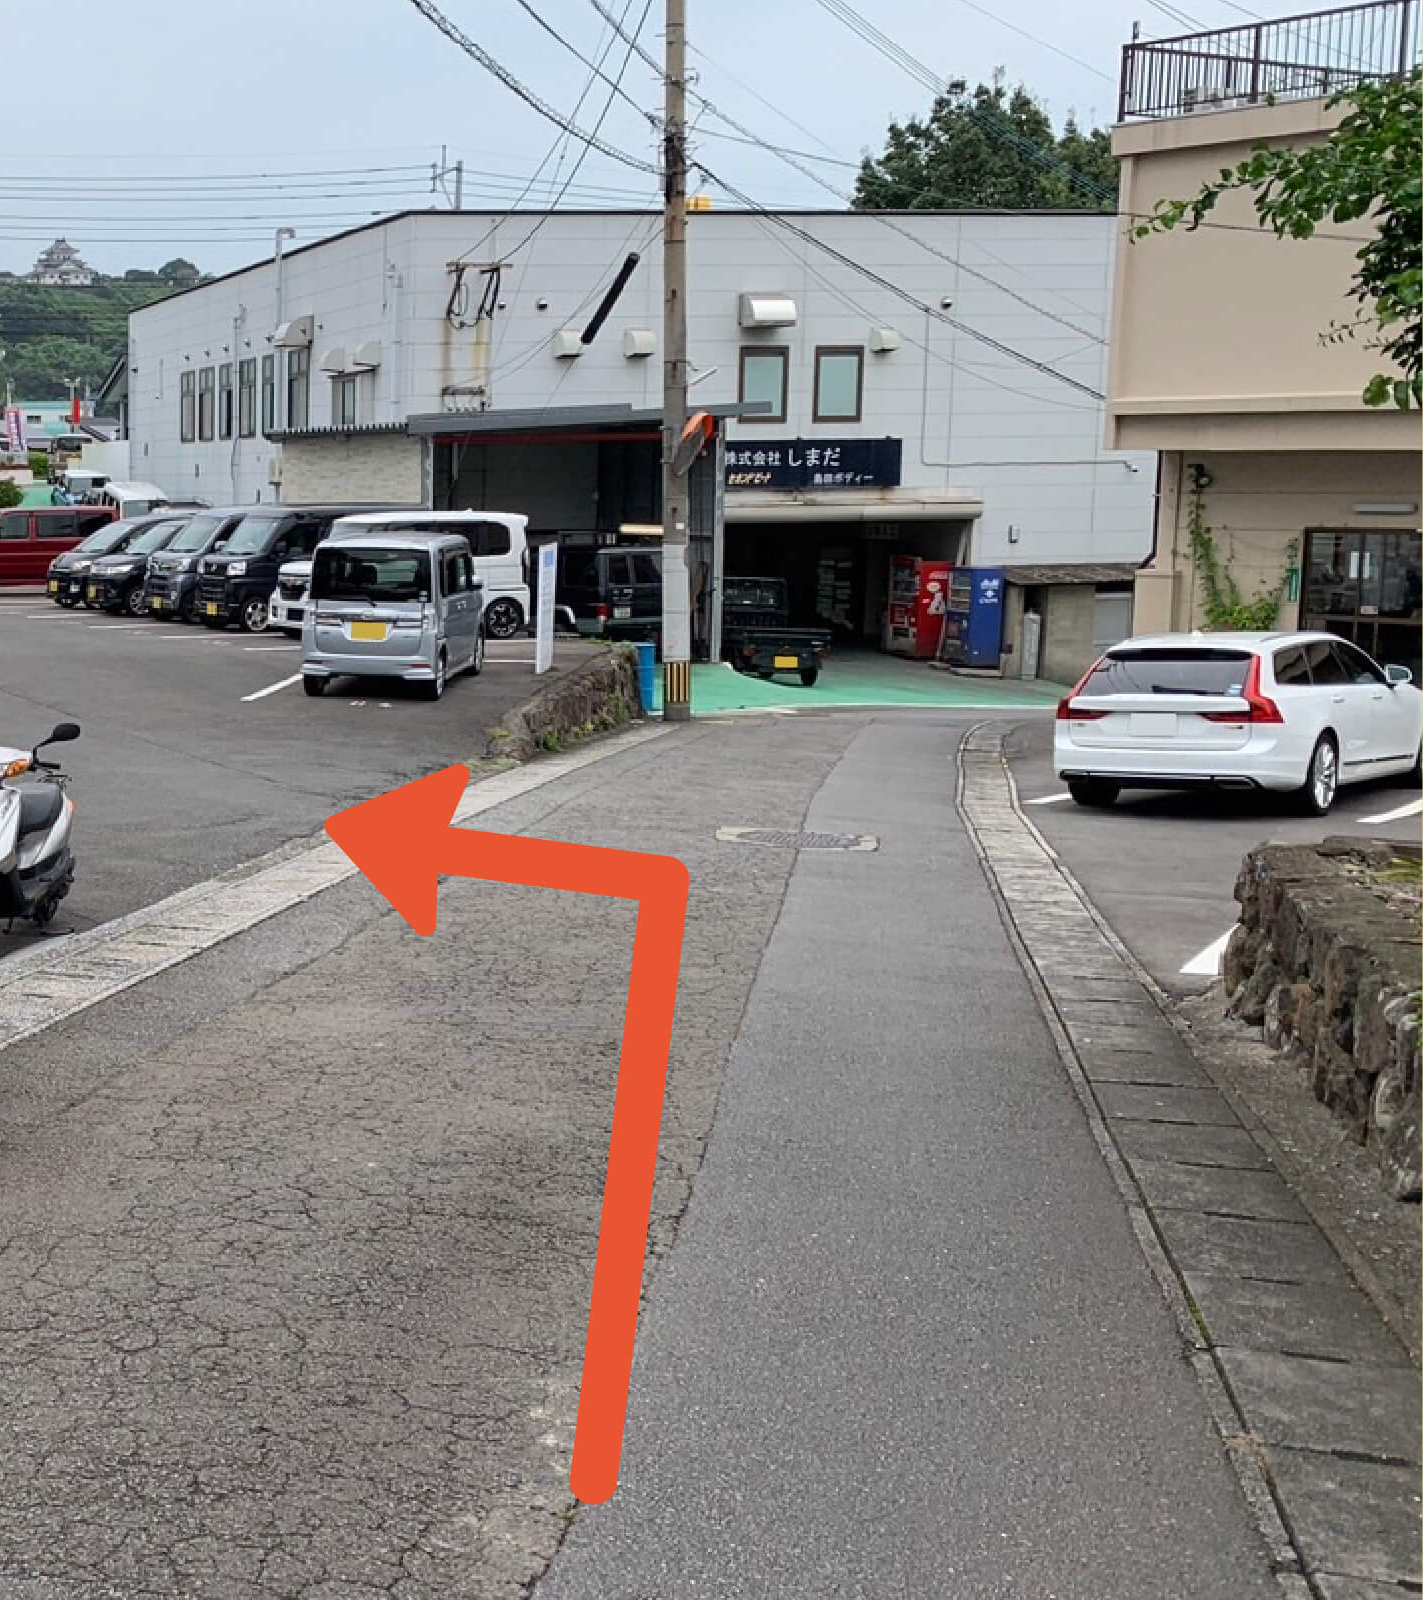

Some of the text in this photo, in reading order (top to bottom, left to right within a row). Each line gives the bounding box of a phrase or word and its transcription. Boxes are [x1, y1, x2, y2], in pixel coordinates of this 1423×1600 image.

[725, 447, 841, 467] 株式会社 しまだ
